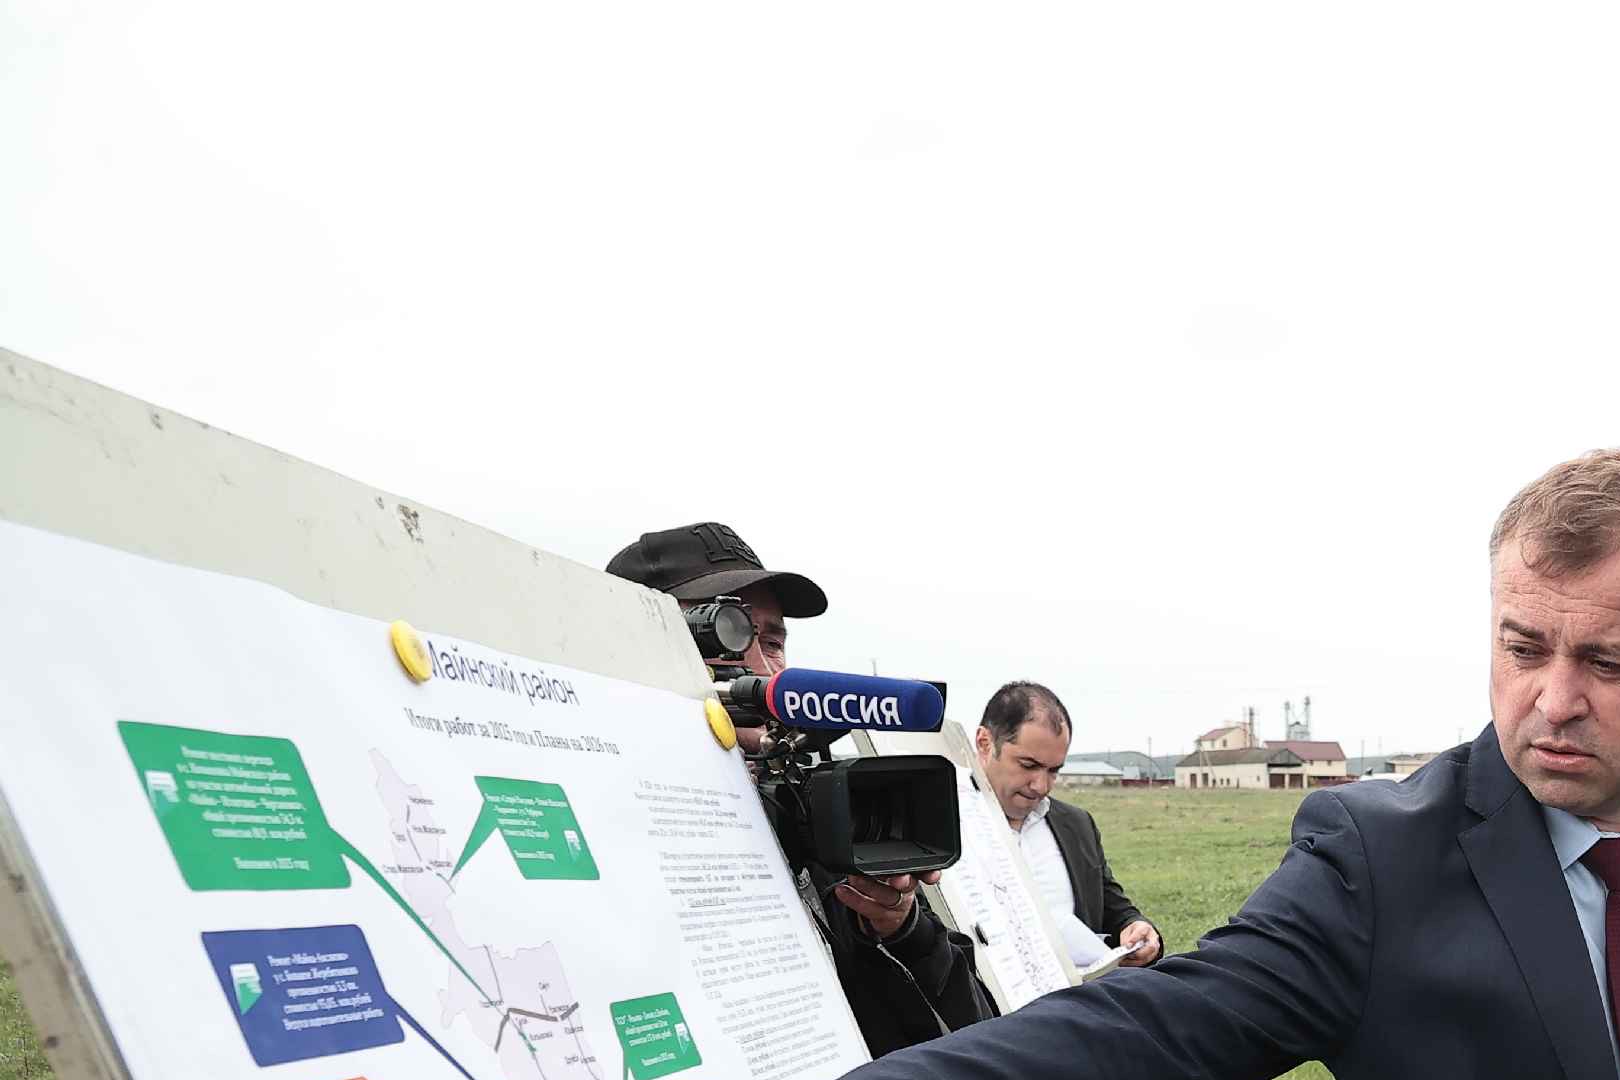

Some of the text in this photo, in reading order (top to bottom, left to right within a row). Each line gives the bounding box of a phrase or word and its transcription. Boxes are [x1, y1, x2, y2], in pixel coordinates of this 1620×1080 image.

[521, 670, 579, 705] район
[783, 690, 903, 726] РОССИЯ
[443, 716, 477, 739] работ
